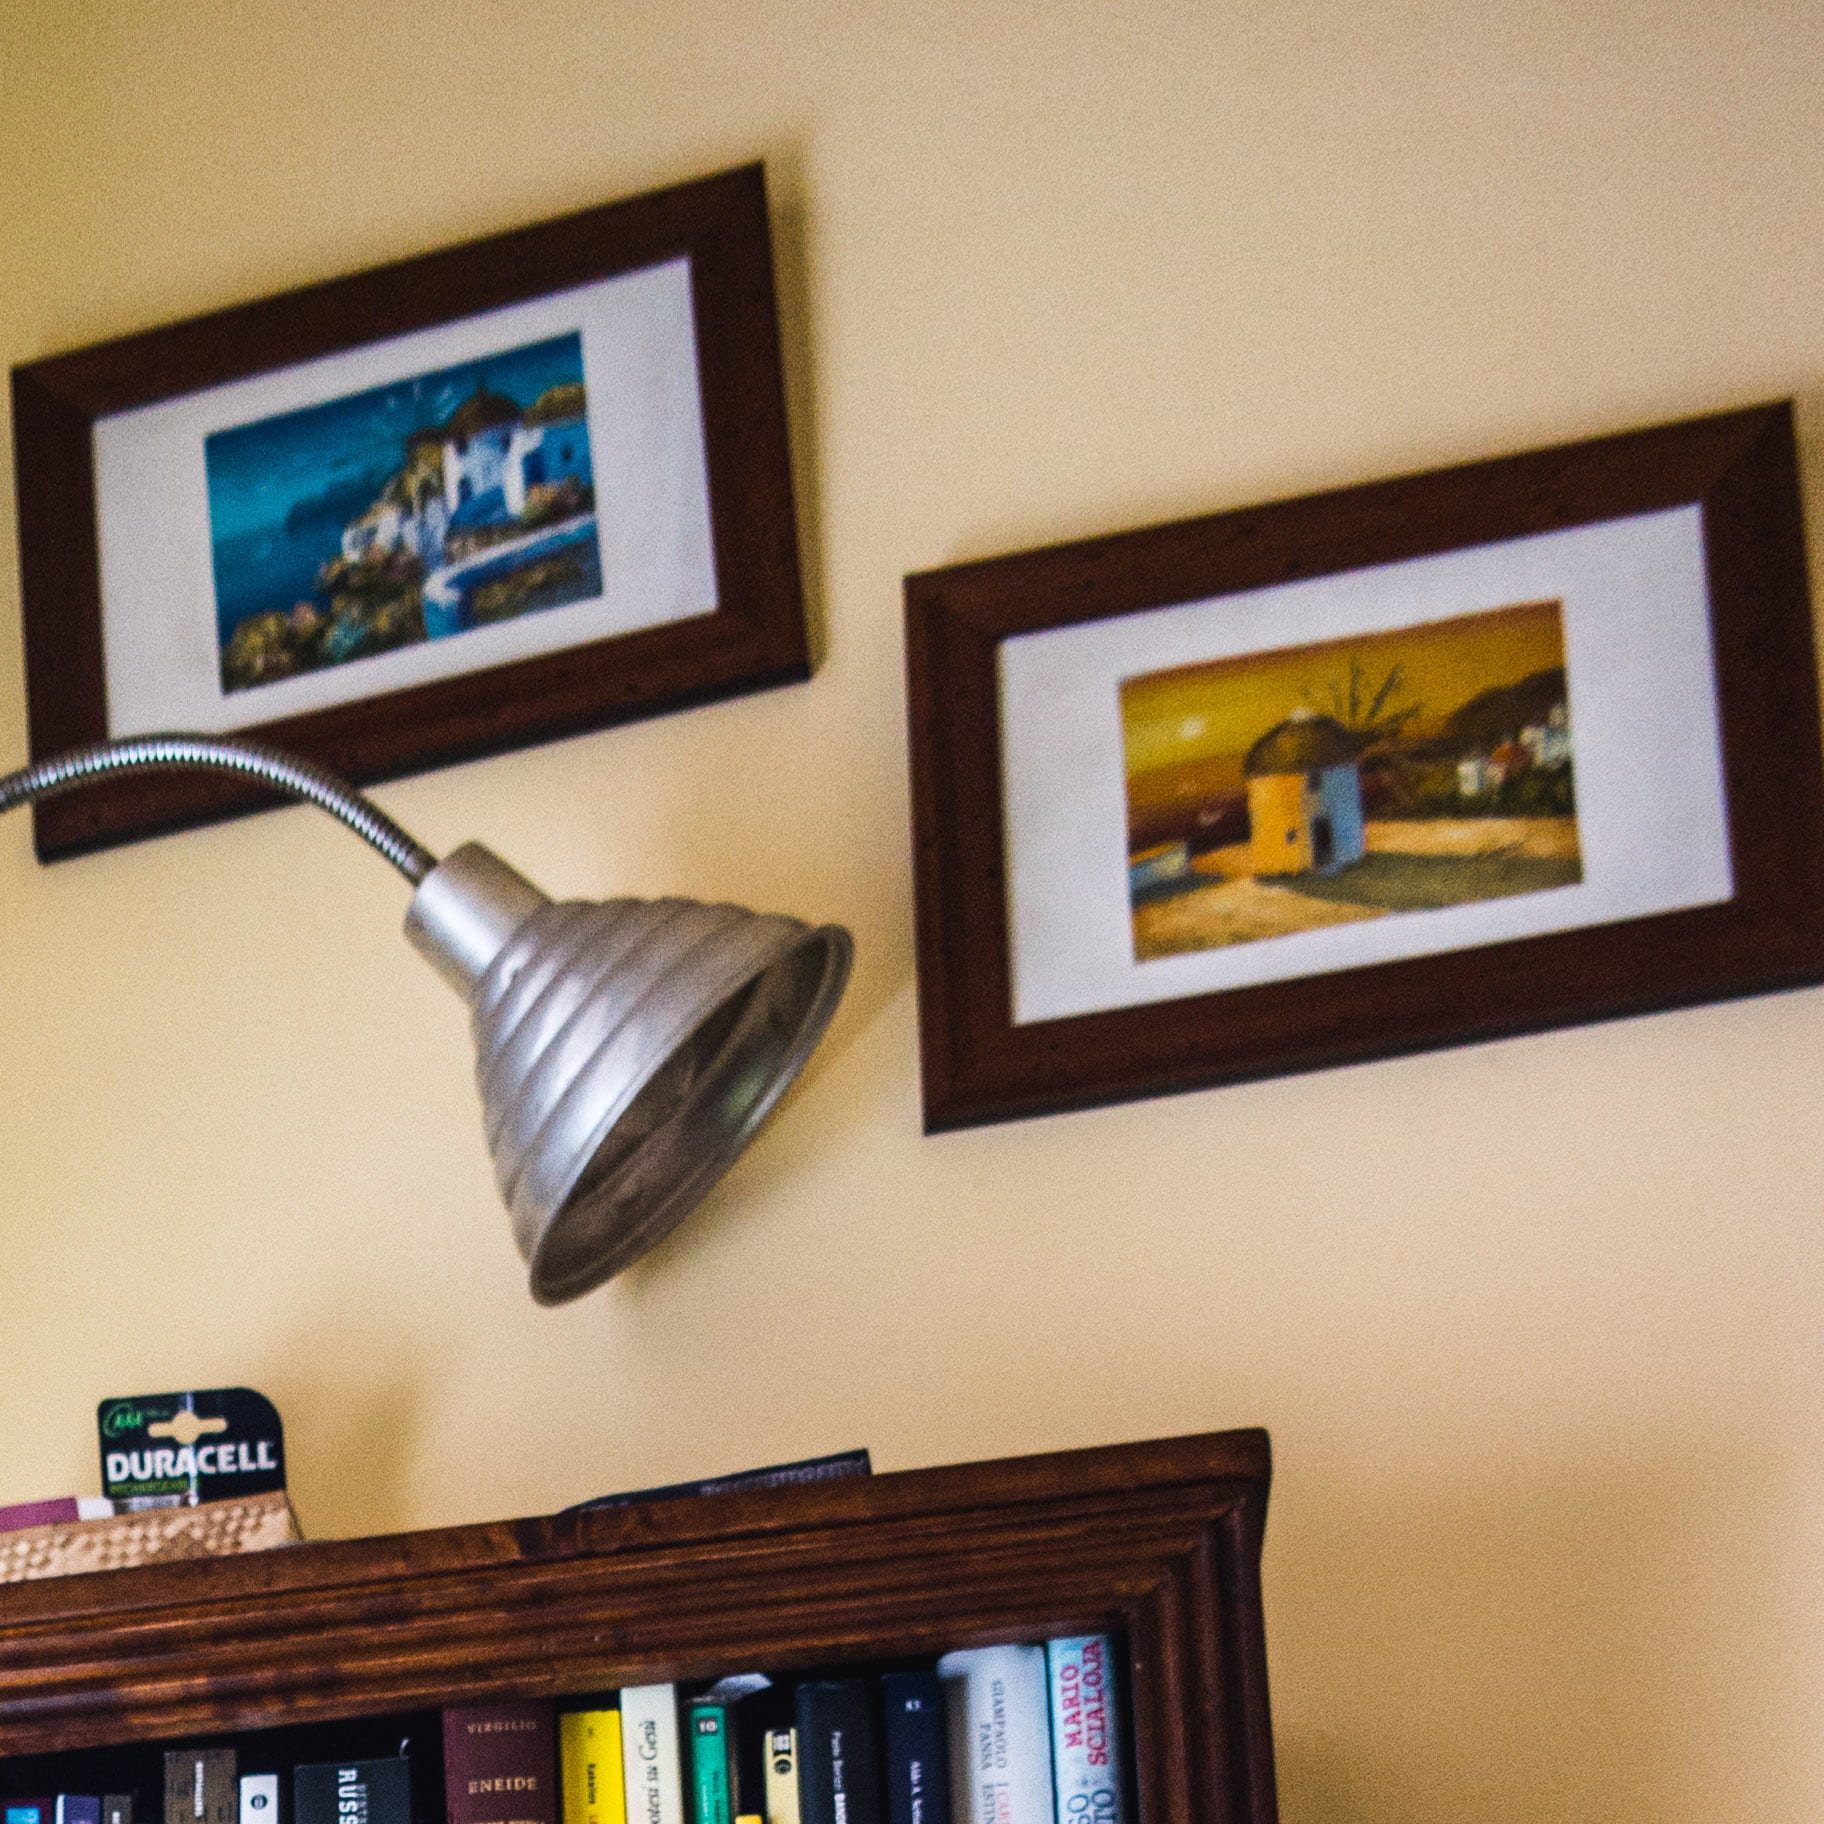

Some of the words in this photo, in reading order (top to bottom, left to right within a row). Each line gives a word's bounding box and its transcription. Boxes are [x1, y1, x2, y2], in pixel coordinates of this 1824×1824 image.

[105, 1440, 277, 1483] DURACELL
[1059, 1663, 1084, 1749] MARIO
[466, 1719, 537, 1734] VIRGILIO
[467, 1776, 539, 1796] ENEIDE
